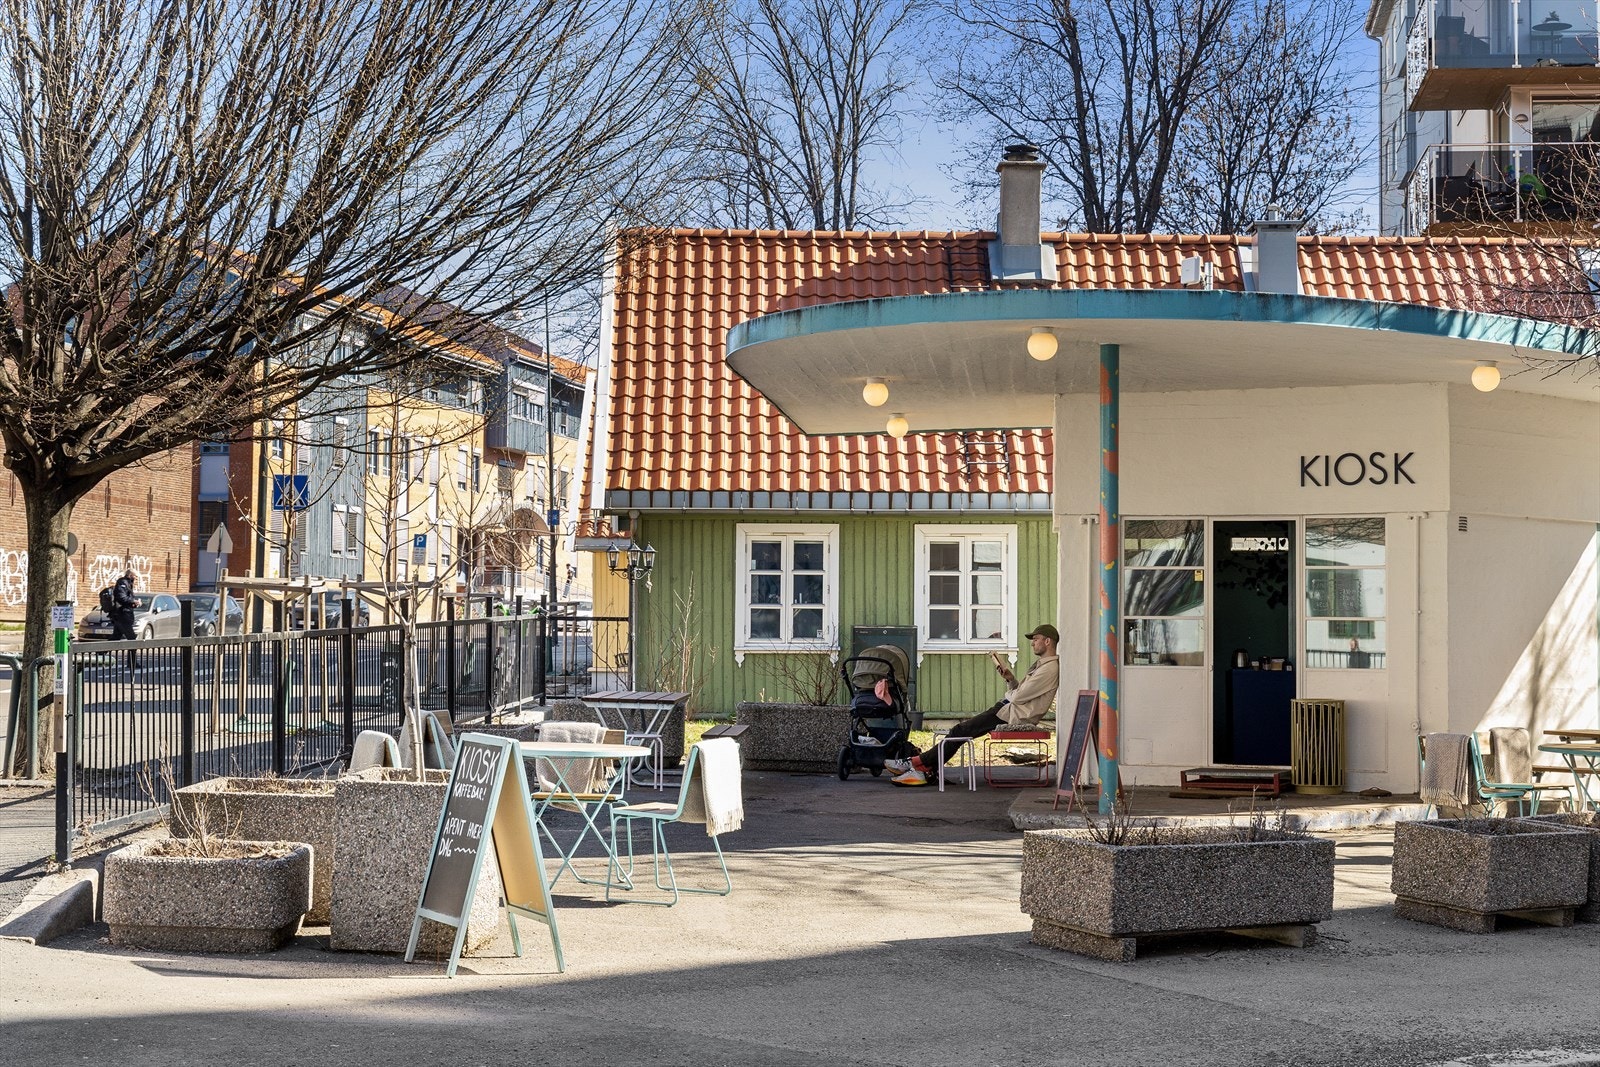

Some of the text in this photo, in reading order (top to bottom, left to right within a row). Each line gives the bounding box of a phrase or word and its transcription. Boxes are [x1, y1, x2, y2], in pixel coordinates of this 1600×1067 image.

[1300, 451, 1416, 487] KIOSK
[416, 535, 424, 546] P
[457, 745, 501, 786] KIOSK
[452, 781, 487, 801] KAFFEBAR!
[443, 811, 467, 836] ÅPENT
[438, 837, 454, 857] DAG
